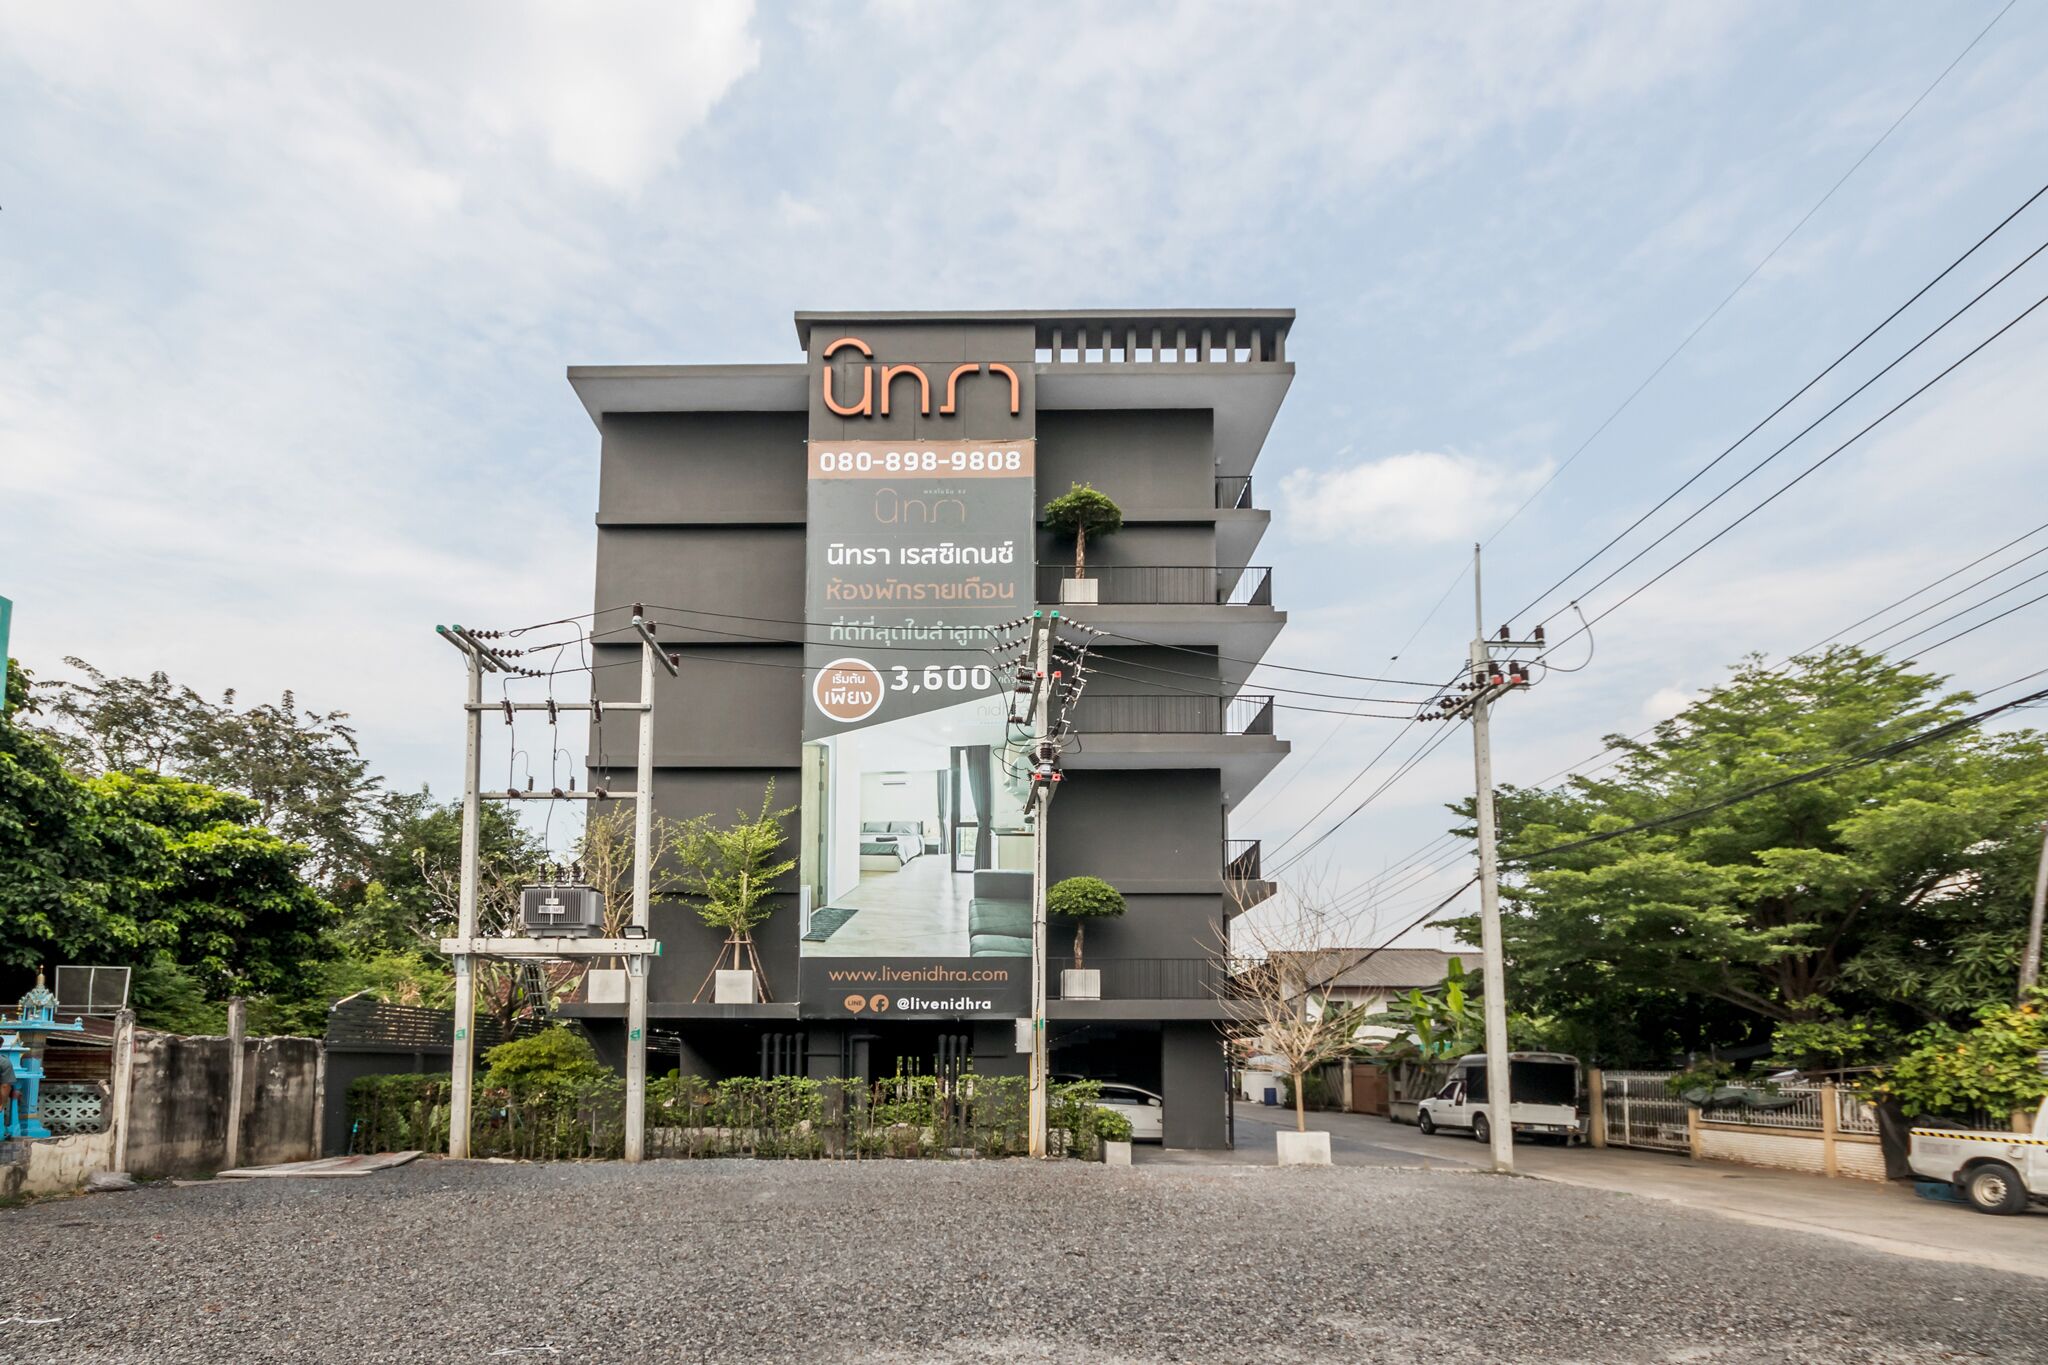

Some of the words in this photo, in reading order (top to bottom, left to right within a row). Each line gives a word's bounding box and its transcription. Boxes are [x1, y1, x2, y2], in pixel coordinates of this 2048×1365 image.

[820, 451, 1021, 472] 080-898-9808
[827, 543, 890, 565] นิทรา
[826, 576, 1014, 600] ห้องพักรายเดือน
[832, 670, 866, 684] เริ่มต้น
[890, 665, 992, 694] 3,600
[825, 686, 873, 705] เพียง
[828, 965, 1009, 982] www.livenidhra.com
[896, 997, 992, 1011] @livenidhra
